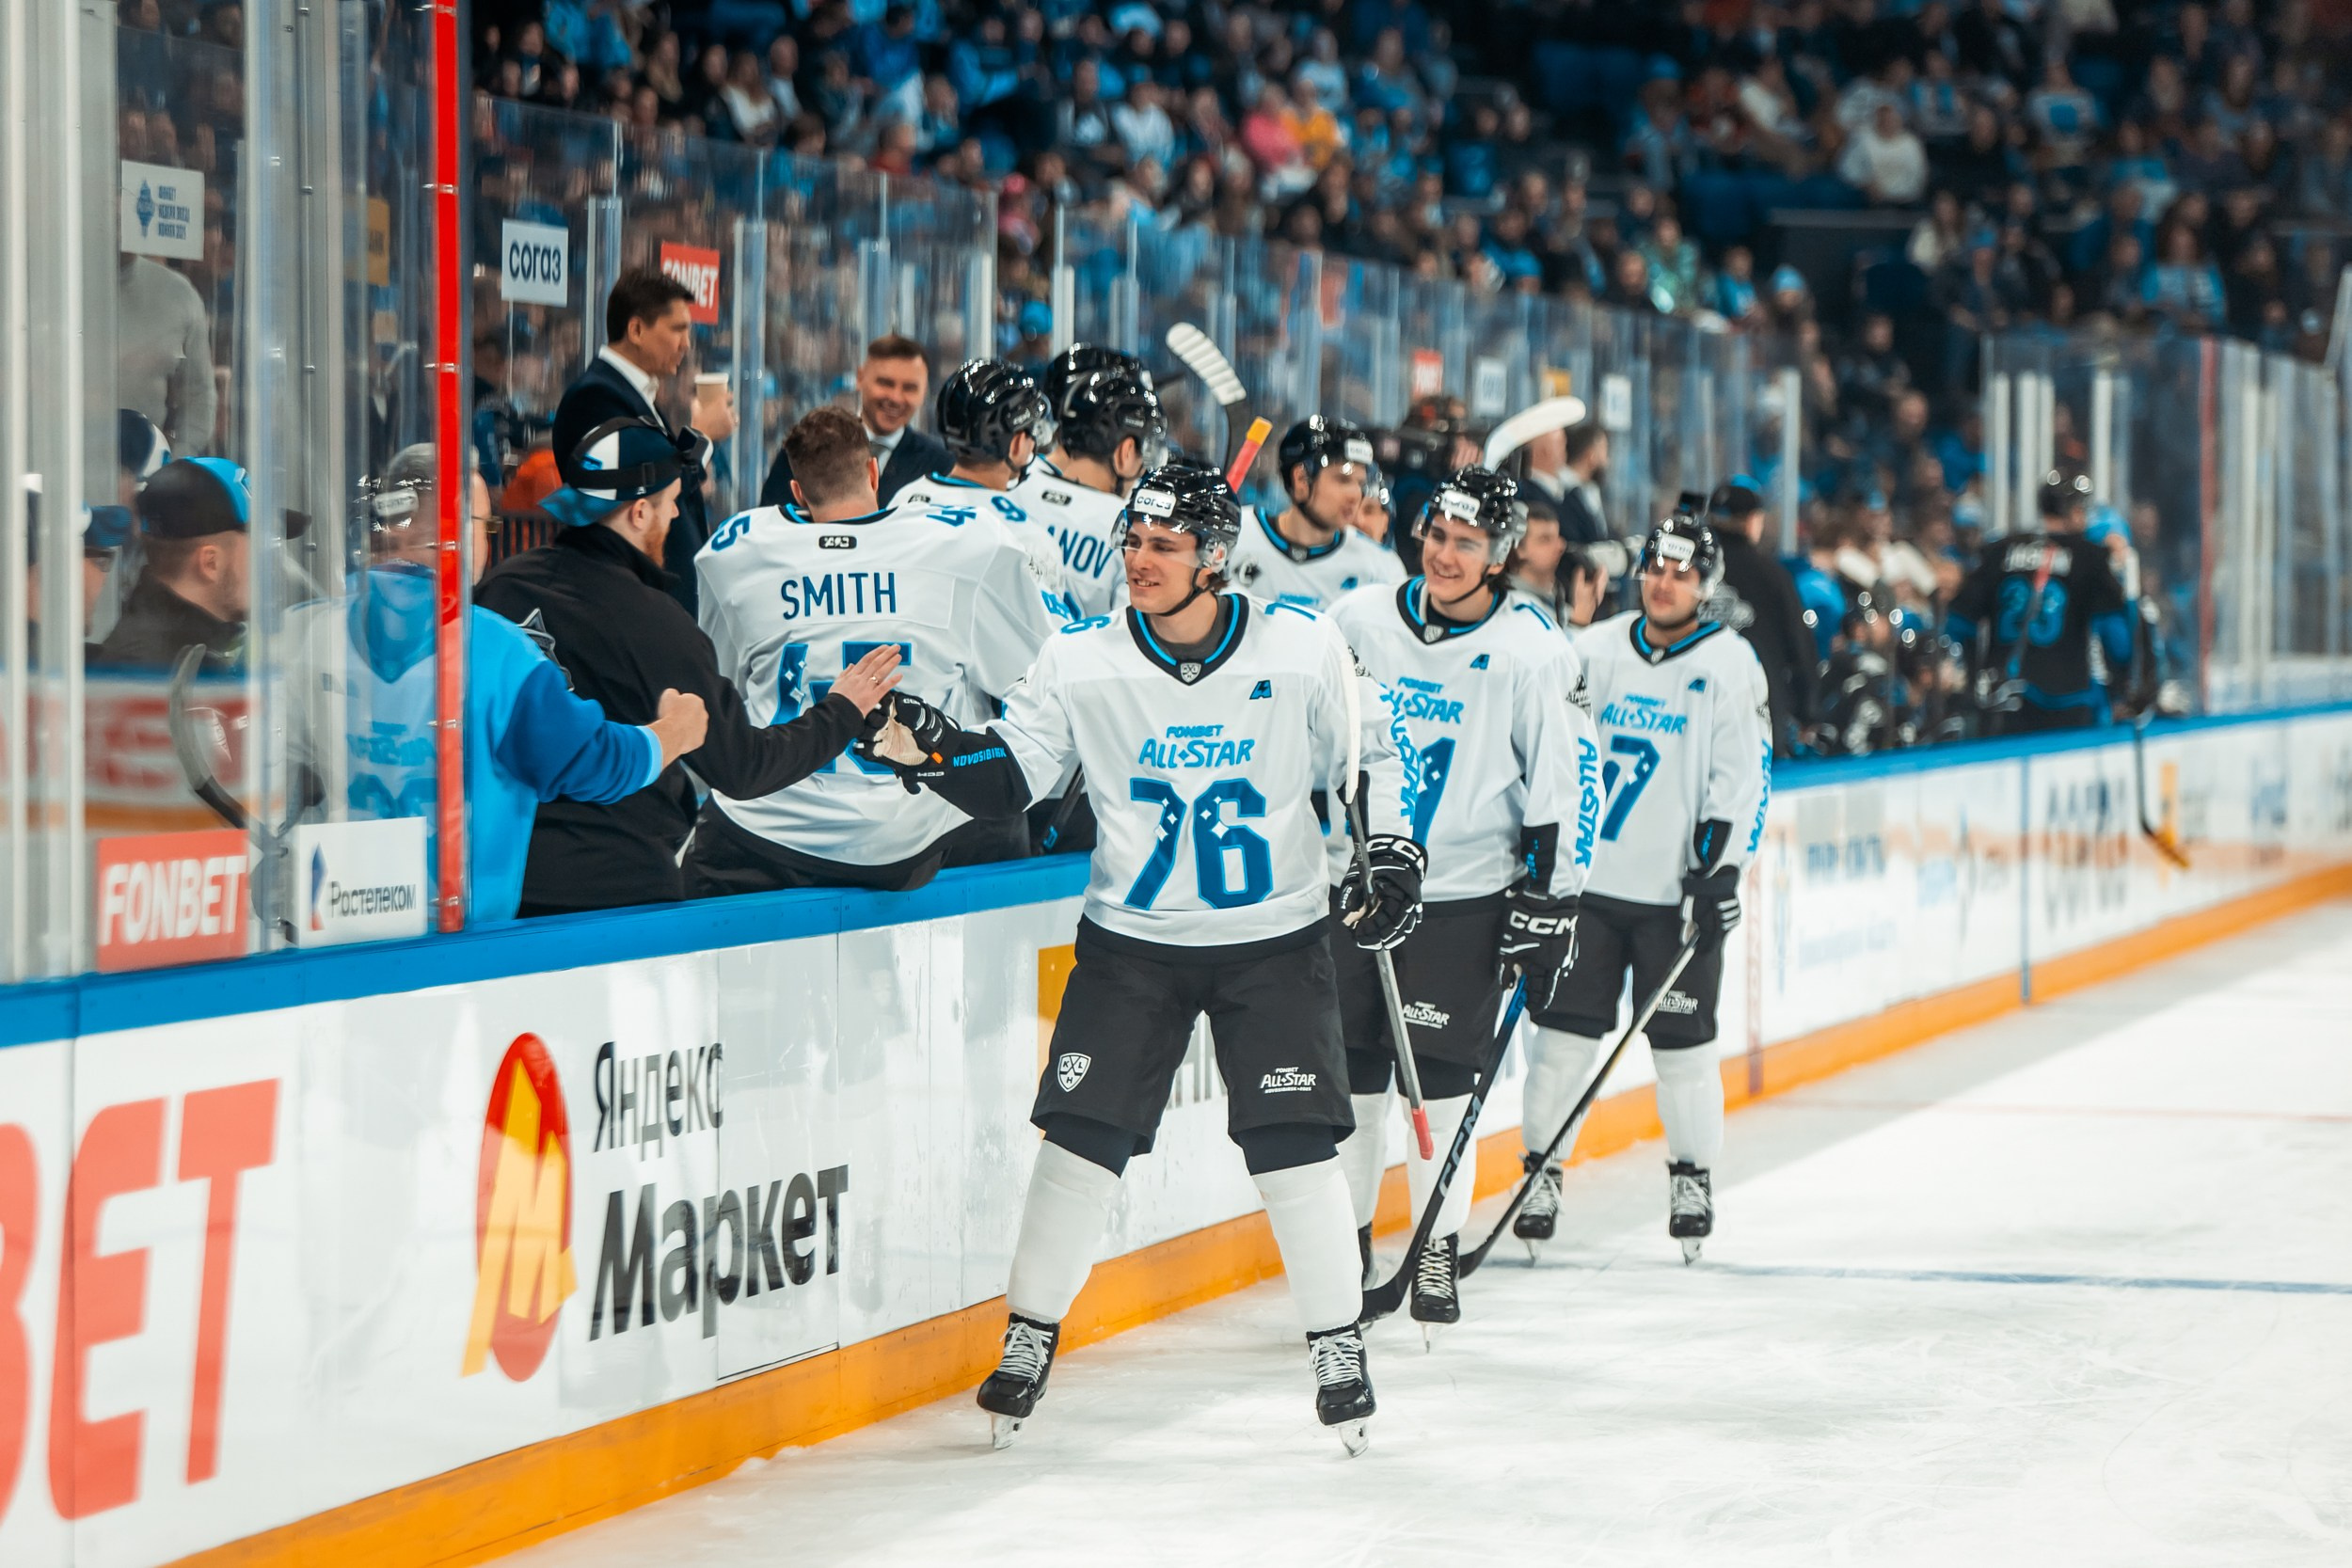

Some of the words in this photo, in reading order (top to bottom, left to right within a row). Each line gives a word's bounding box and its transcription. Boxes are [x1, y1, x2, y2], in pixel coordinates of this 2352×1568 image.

[780, 571, 898, 621] SMITH
[1167, 724, 1224, 738] FONBET
[1124, 777, 1274, 911] 76
[101, 855, 247, 946] FONBET
[330, 880, 417, 918] Ростелеком
[1510, 910, 1579, 935] CCM
[593, 1041, 724, 1162] Яндекс
[589, 1164, 850, 1343] Маркет
